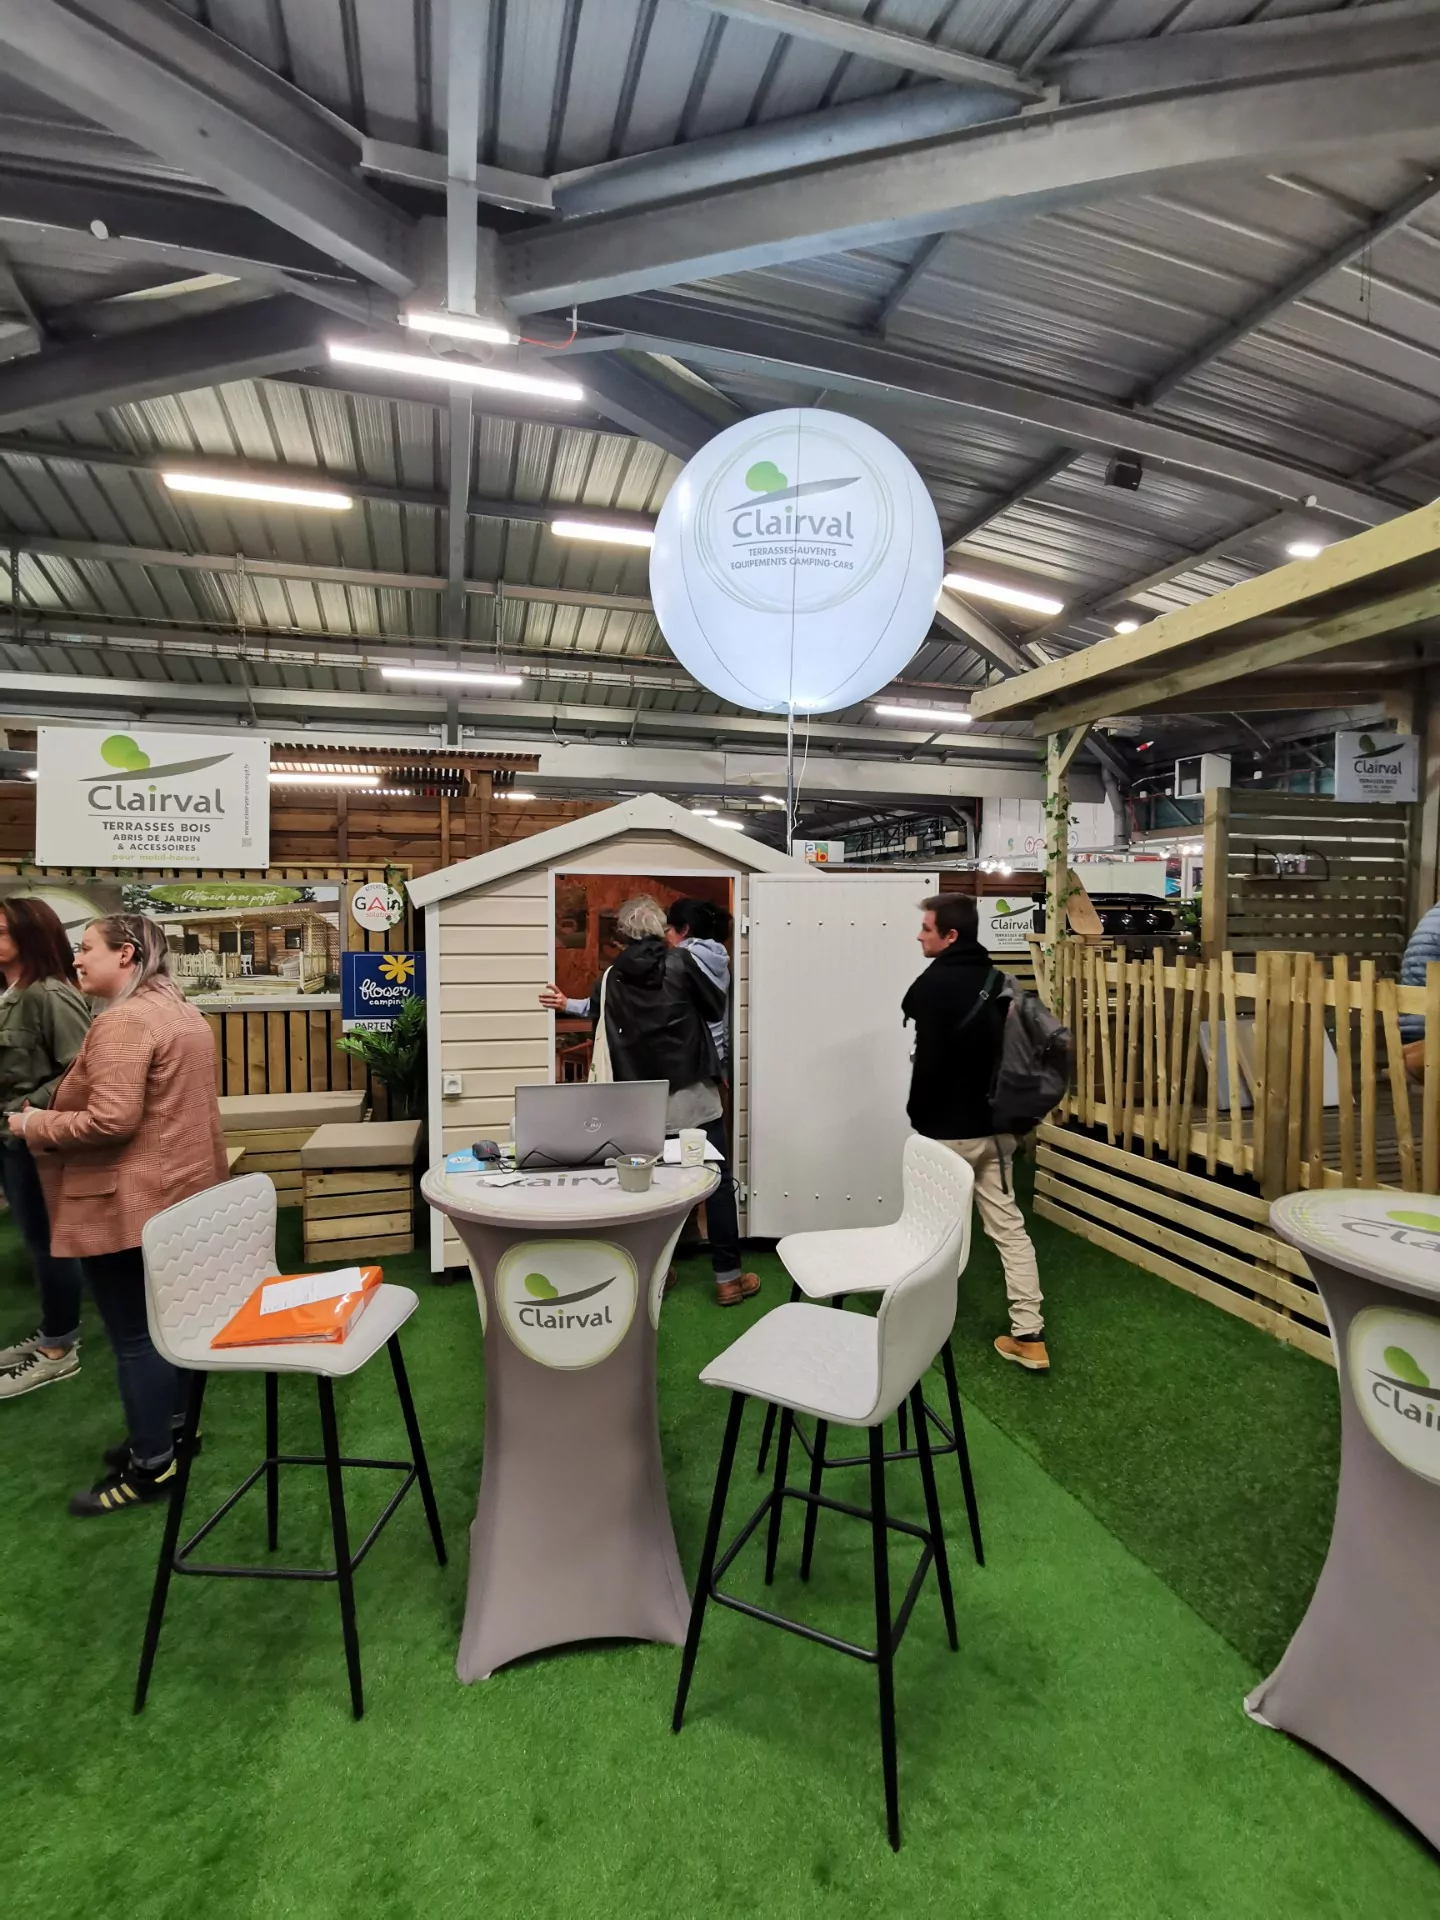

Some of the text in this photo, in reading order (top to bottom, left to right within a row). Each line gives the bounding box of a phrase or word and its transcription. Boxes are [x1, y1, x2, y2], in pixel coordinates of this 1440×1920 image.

[732, 505, 855, 540] Clairval
[731, 558, 854, 571] EQUIPEMENTS CAMPING-CARS
[1353, 760, 1402, 775] Clairval
[88, 784, 225, 814] Clairval
[102, 821, 211, 833] TERRASSES BOIS
[112, 833, 201, 843] ABRIS DE JARDIN
[129, 843, 196, 852] ACCESSOIRES
[990, 918, 1034, 930] Clairval
[359, 978, 411, 1000] flower
[369, 997, 404, 1007] campin
[355, 1022, 394, 1032] PARTEN
[518, 1306, 613, 1330] Clairval
